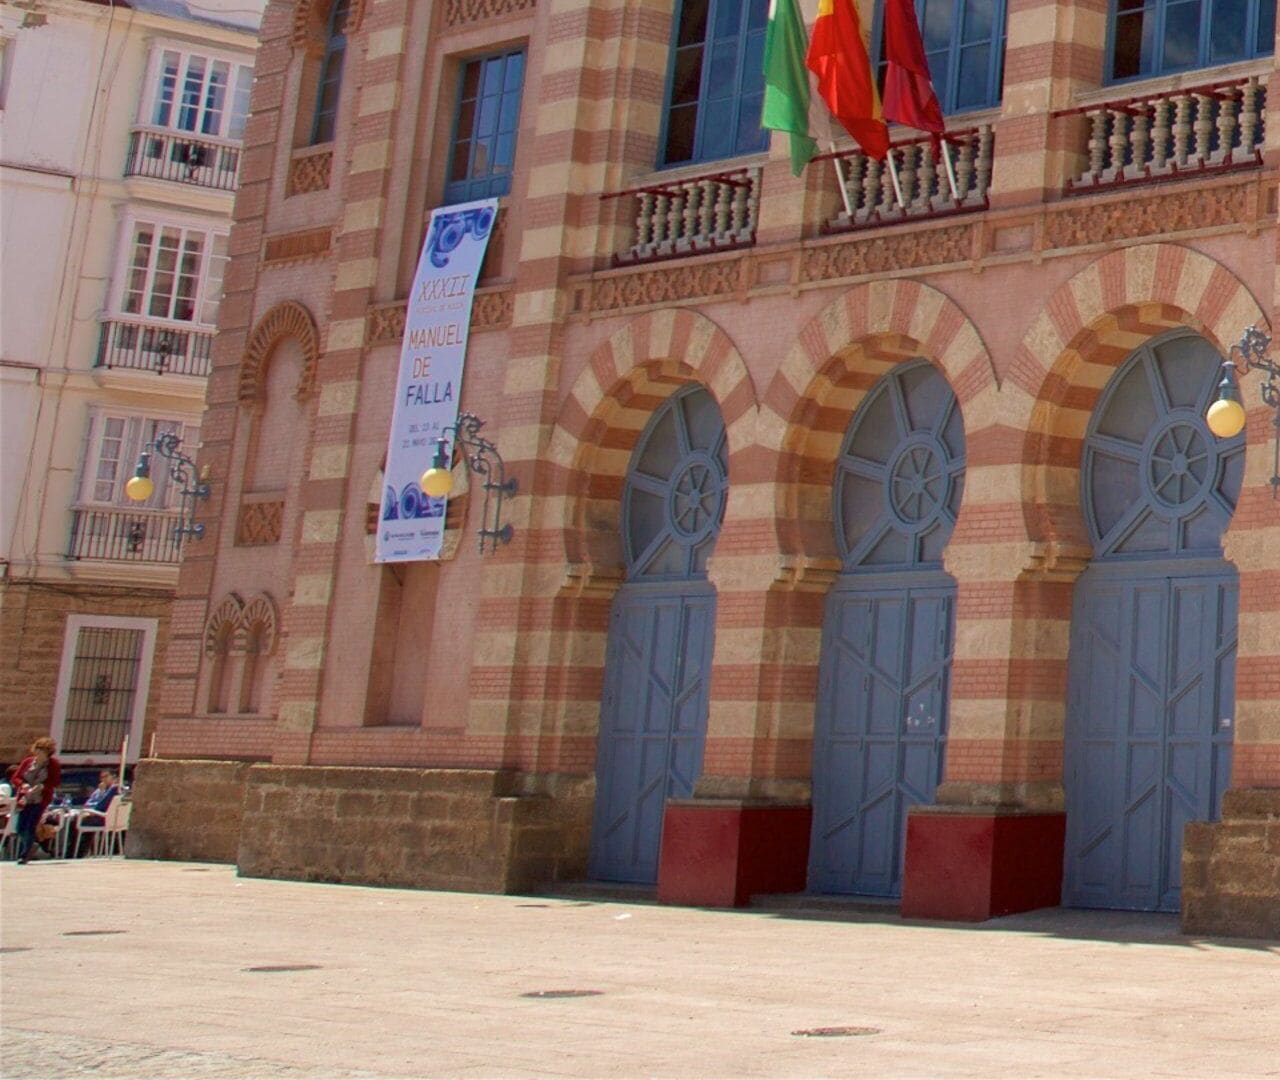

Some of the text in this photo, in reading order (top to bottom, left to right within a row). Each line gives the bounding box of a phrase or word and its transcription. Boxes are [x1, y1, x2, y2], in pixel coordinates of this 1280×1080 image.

[418, 274, 470, 302] XXXII
[408, 324, 463, 351] MANUEL
[413, 356, 432, 379] DE
[406, 381, 453, 407] FALLA
